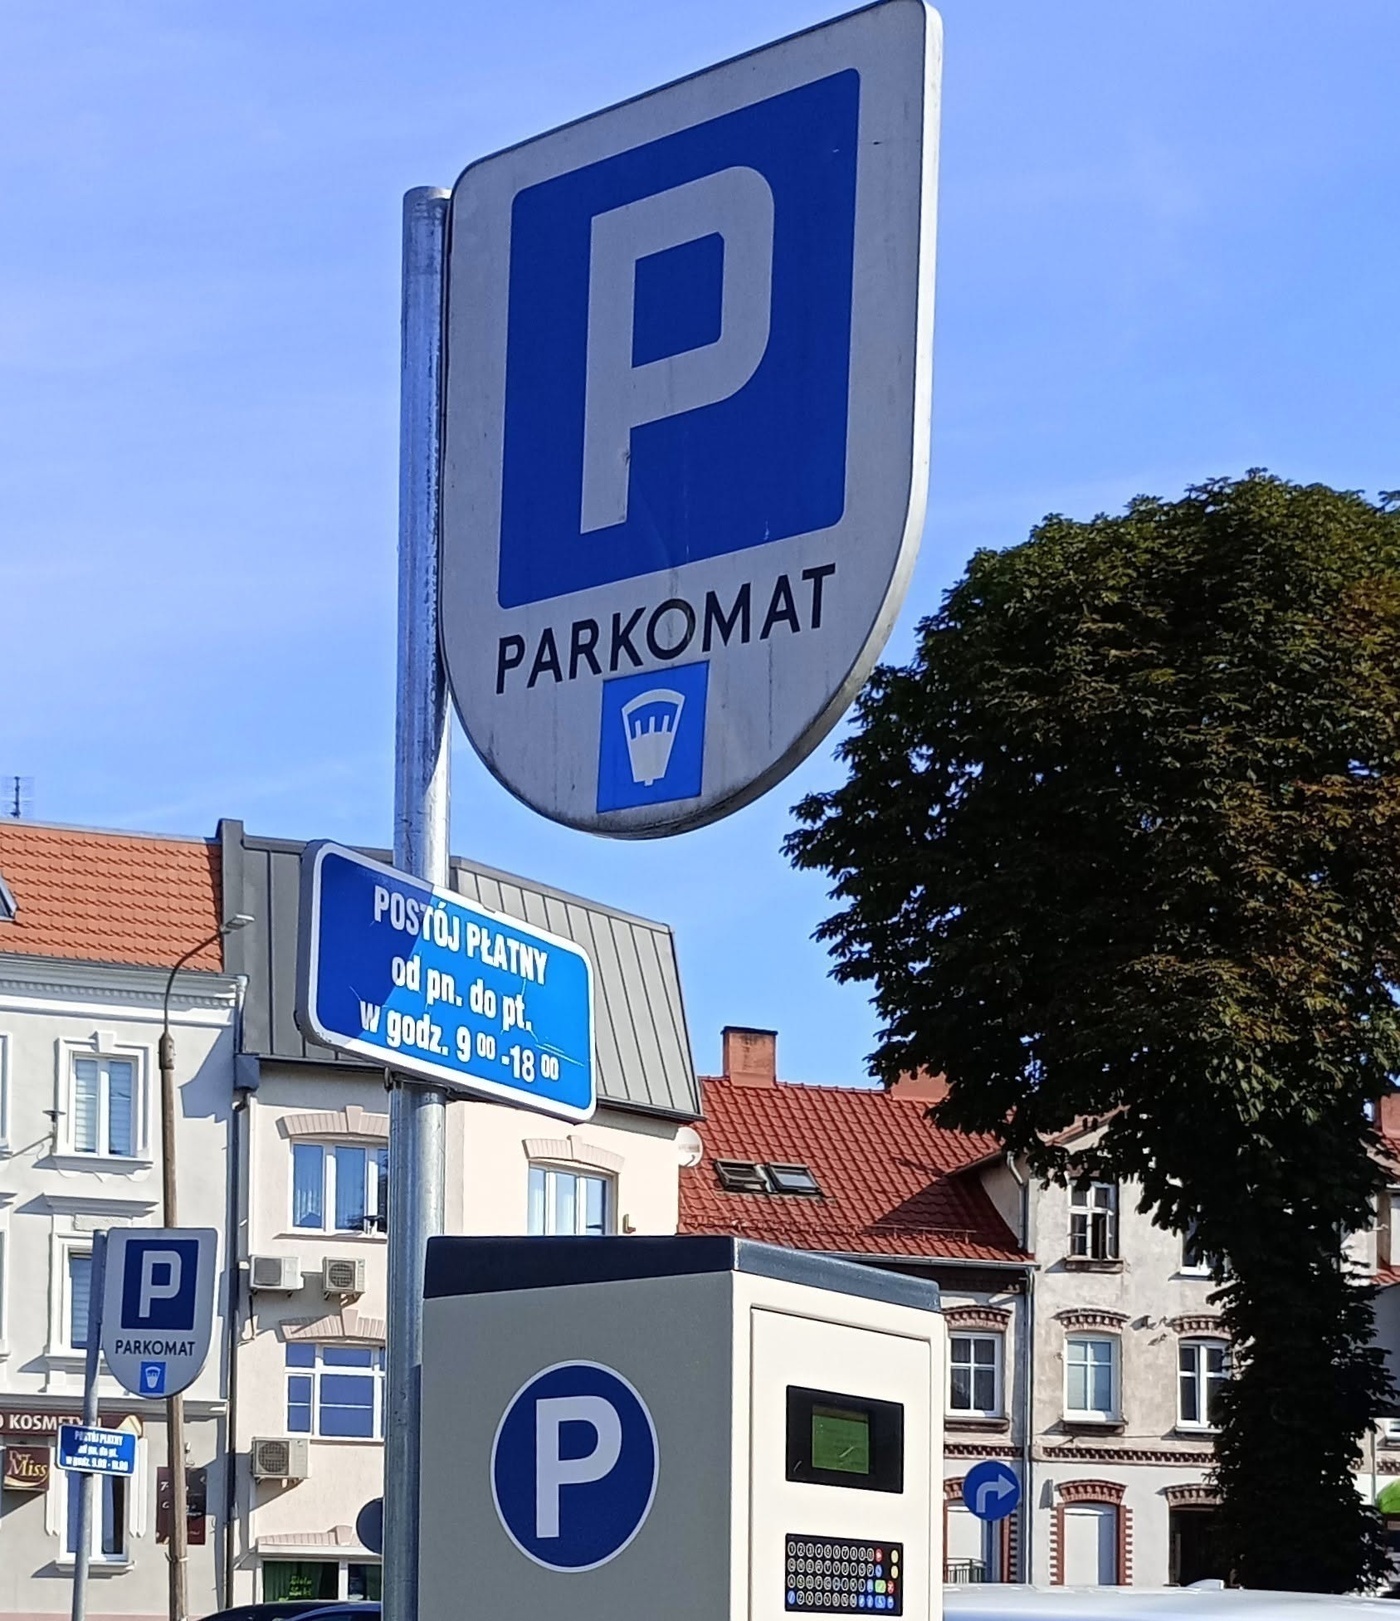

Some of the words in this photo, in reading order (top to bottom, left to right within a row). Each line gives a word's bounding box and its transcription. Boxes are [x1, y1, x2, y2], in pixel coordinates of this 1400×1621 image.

[580, 166, 775, 534] P
[496, 563, 836, 695] PARKOMAT
[374, 885, 460, 952] POSTÓJ
[466, 921, 548, 986] PŁATNY
[391, 955, 421, 992] od
[426, 968, 462, 1008] pn.
[469, 979, 497, 1019] do
[502, 994, 533, 1032] pt.
[386, 1009, 449, 1056] godz.
[138, 1250, 182, 1318] P
[115, 1340, 196, 1356] PARKOMAT
[6, 1458, 48, 1477] Miss
[536, 1395, 622, 1538] P
